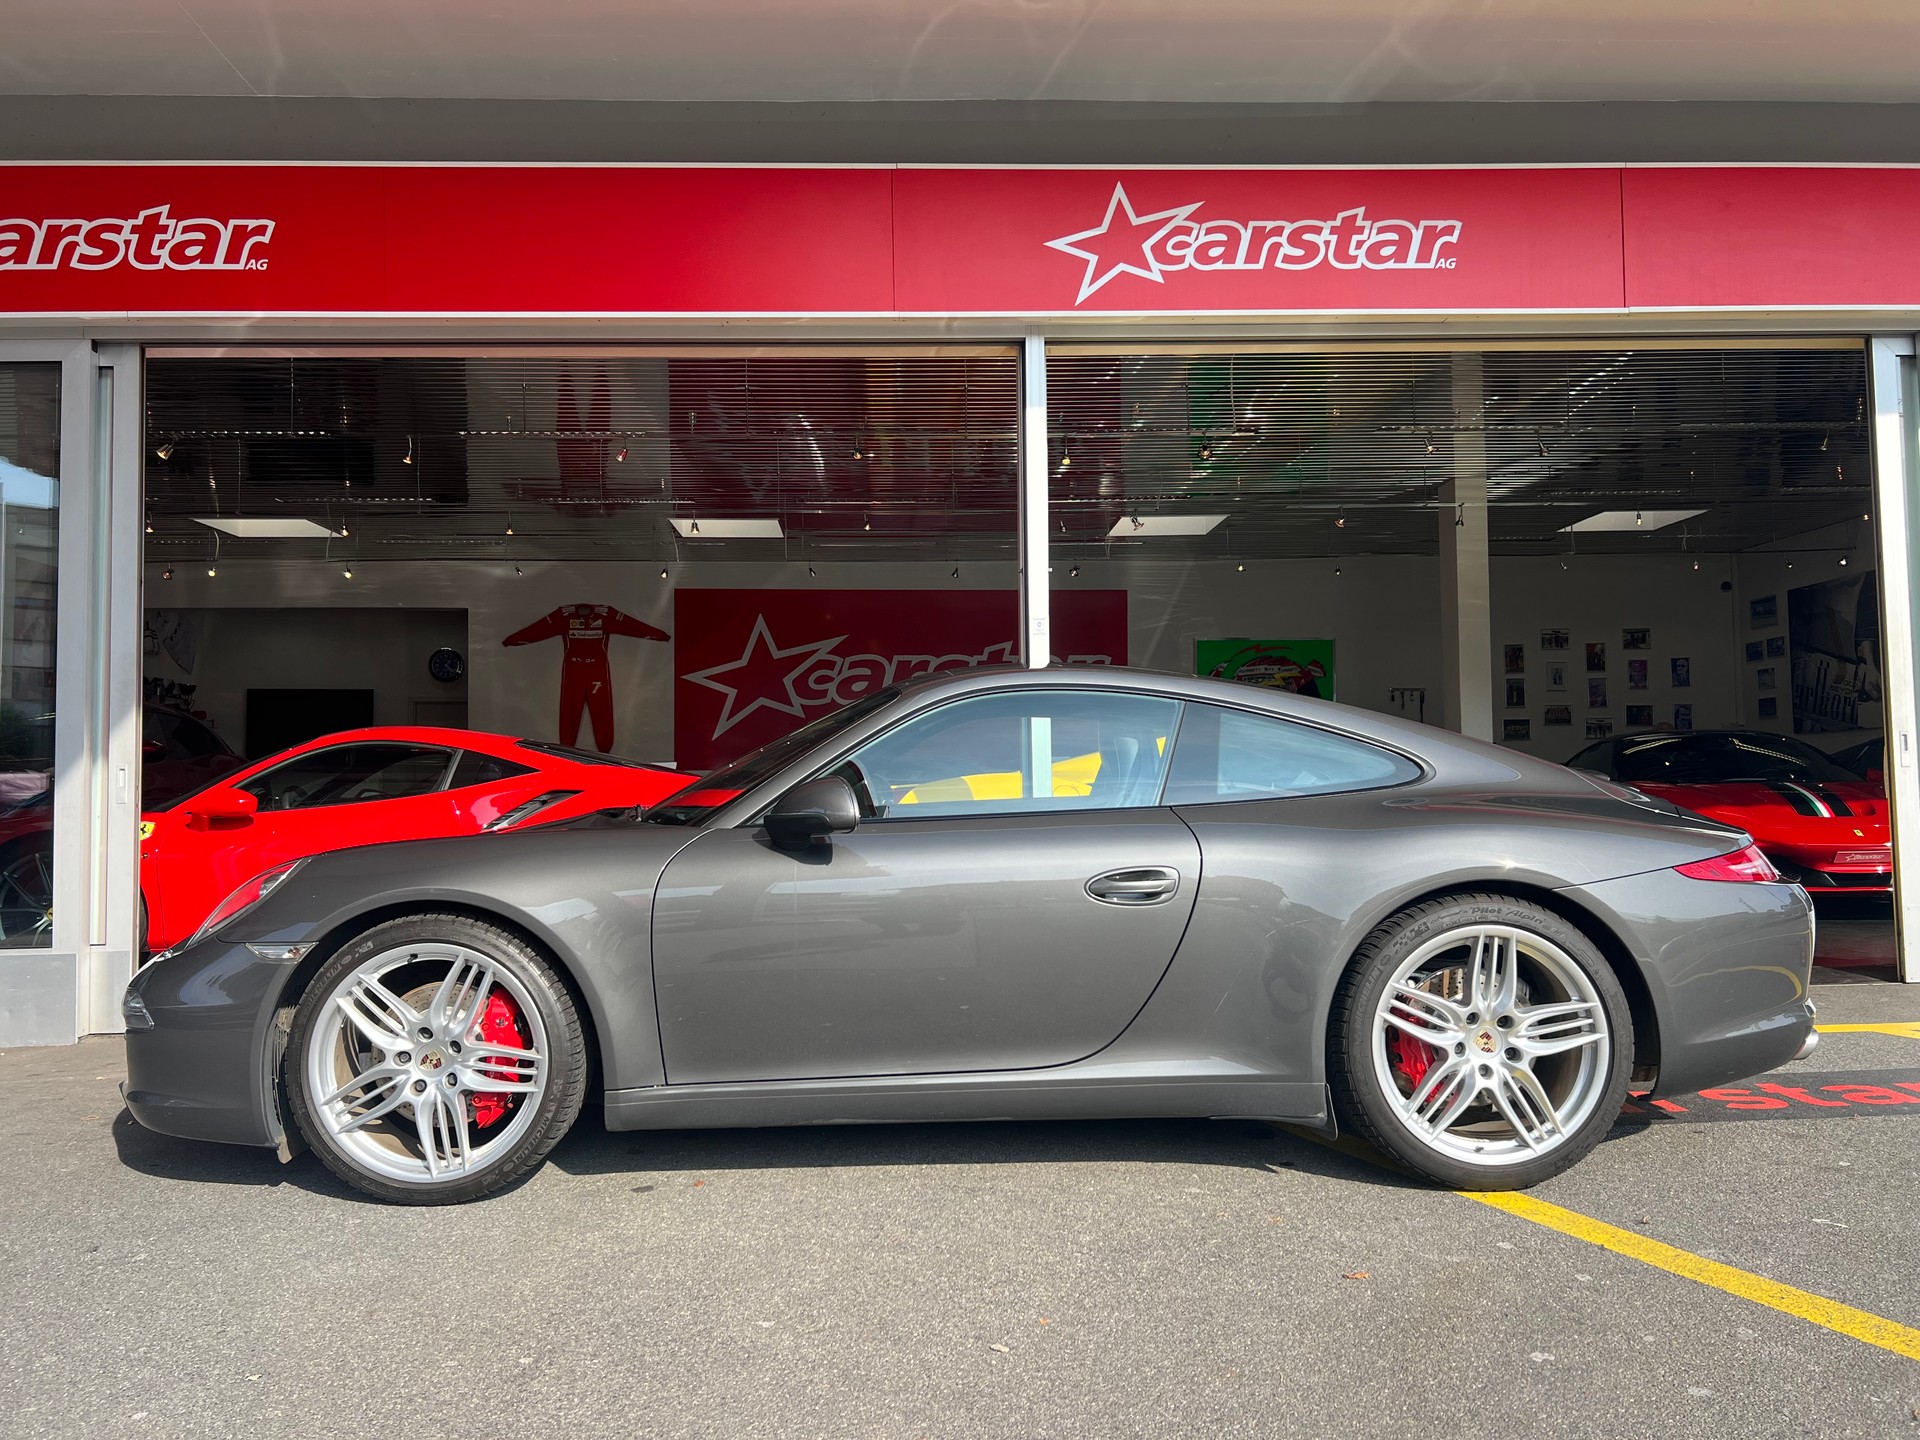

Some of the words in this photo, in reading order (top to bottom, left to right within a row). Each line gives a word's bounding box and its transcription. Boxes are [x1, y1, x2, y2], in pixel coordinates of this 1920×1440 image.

[1145, 206, 1462, 270] carstar
[1435, 258, 1457, 269] AG
[245, 259, 268, 270] AG
[592, 682, 602, 694] 7
[1470, 906, 1503, 915] Pilot
[515, 1115, 551, 1163] MICHELIN
